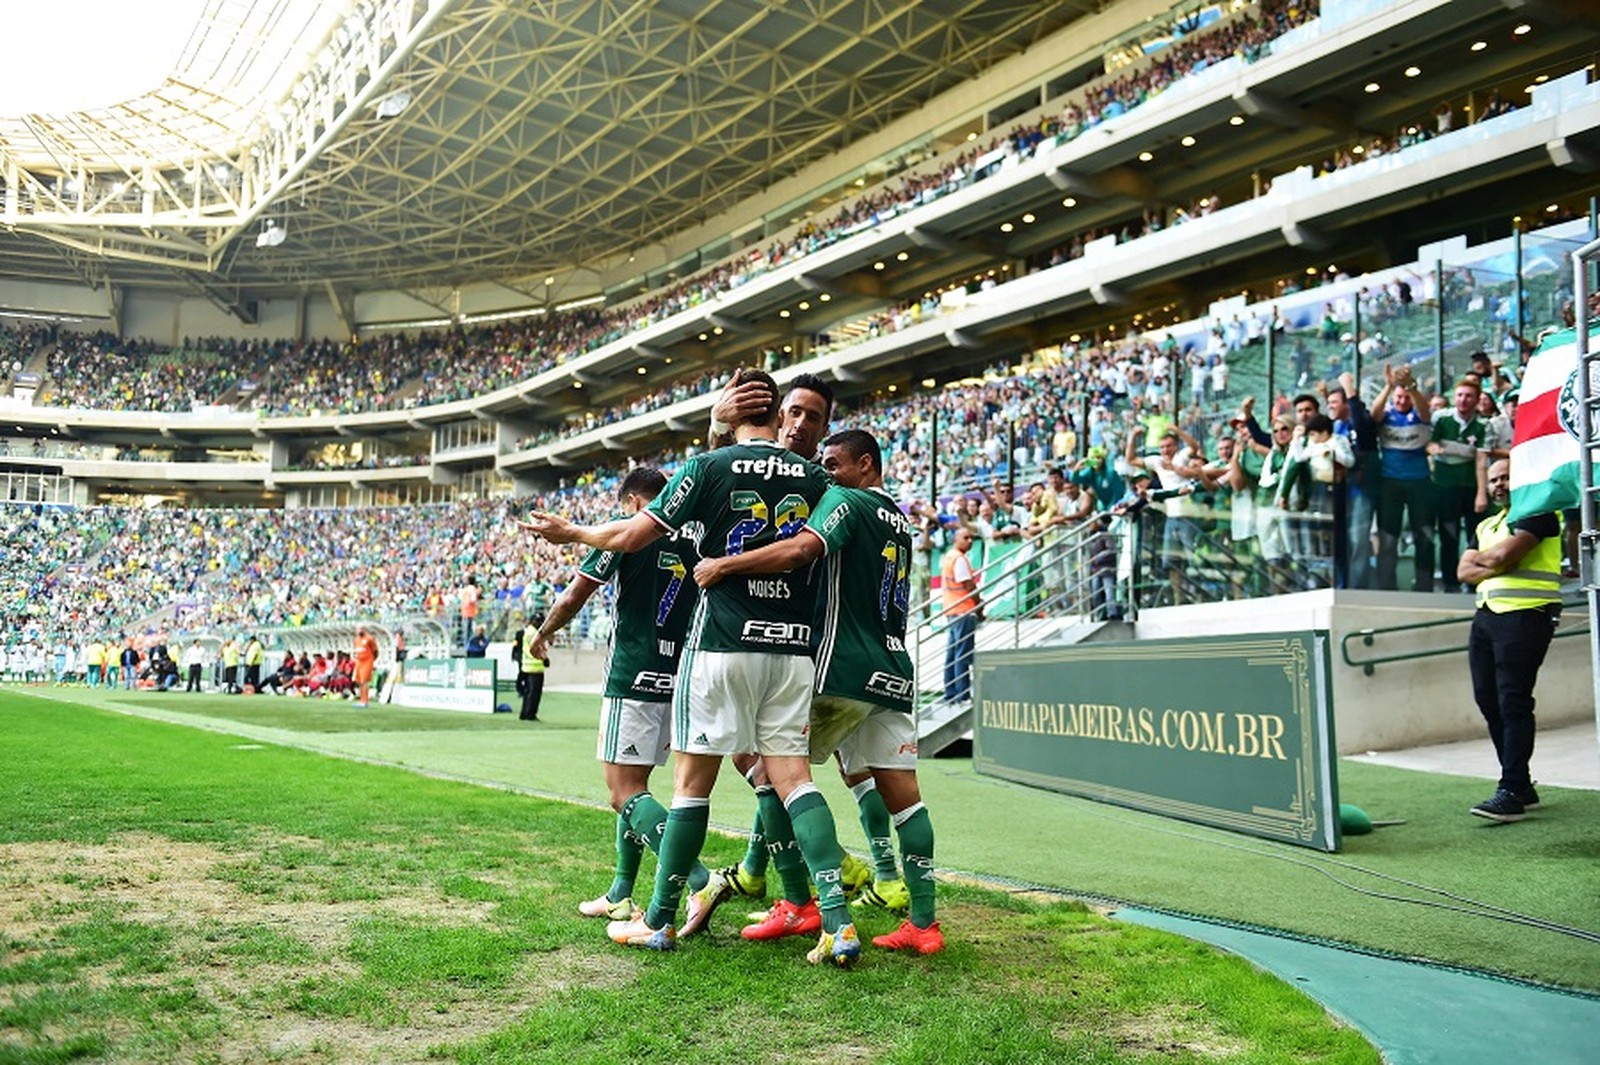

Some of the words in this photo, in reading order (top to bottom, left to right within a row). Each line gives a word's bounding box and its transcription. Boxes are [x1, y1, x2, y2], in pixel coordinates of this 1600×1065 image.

[731, 455, 806, 481] crefisa
[656, 551, 687, 627] 7
[748, 578, 791, 599] MOISÉS
[982, 700, 1287, 760] FAMILIAPALMEIRAS.COM.BR
